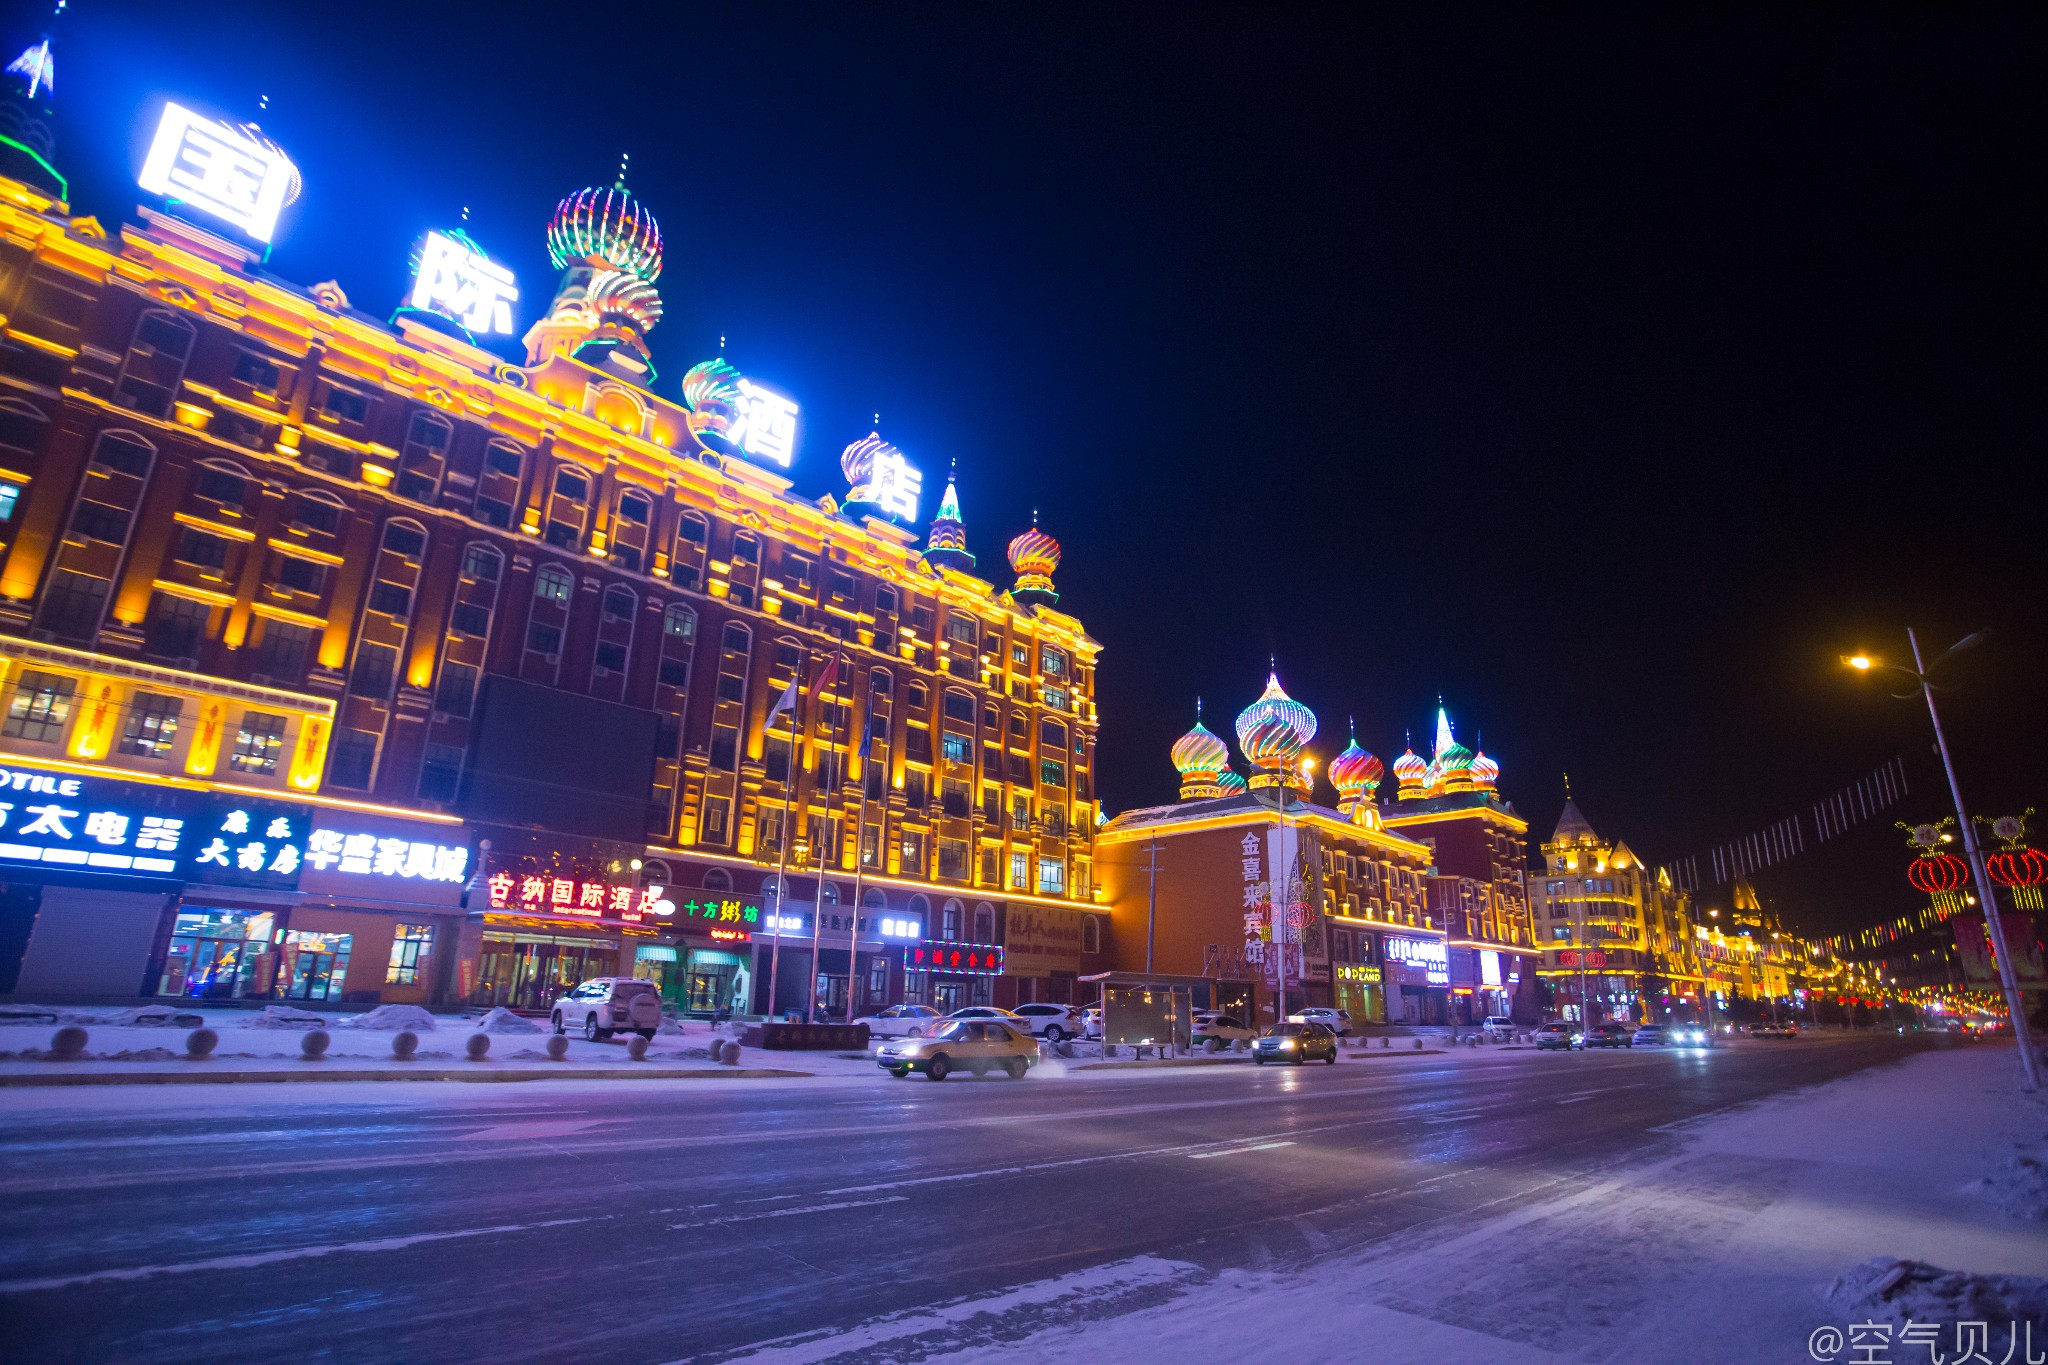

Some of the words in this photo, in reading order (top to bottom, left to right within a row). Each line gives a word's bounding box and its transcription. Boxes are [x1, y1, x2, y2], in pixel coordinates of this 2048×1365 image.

[196, 838, 300, 874] 大药房
[304, 828, 468, 884] 华盛家具城
[684, 899, 759, 923] 十方粥坊
[1241, 831, 1265, 963] 金喜来宾馆
[1358, 972, 1381, 982] LAND
